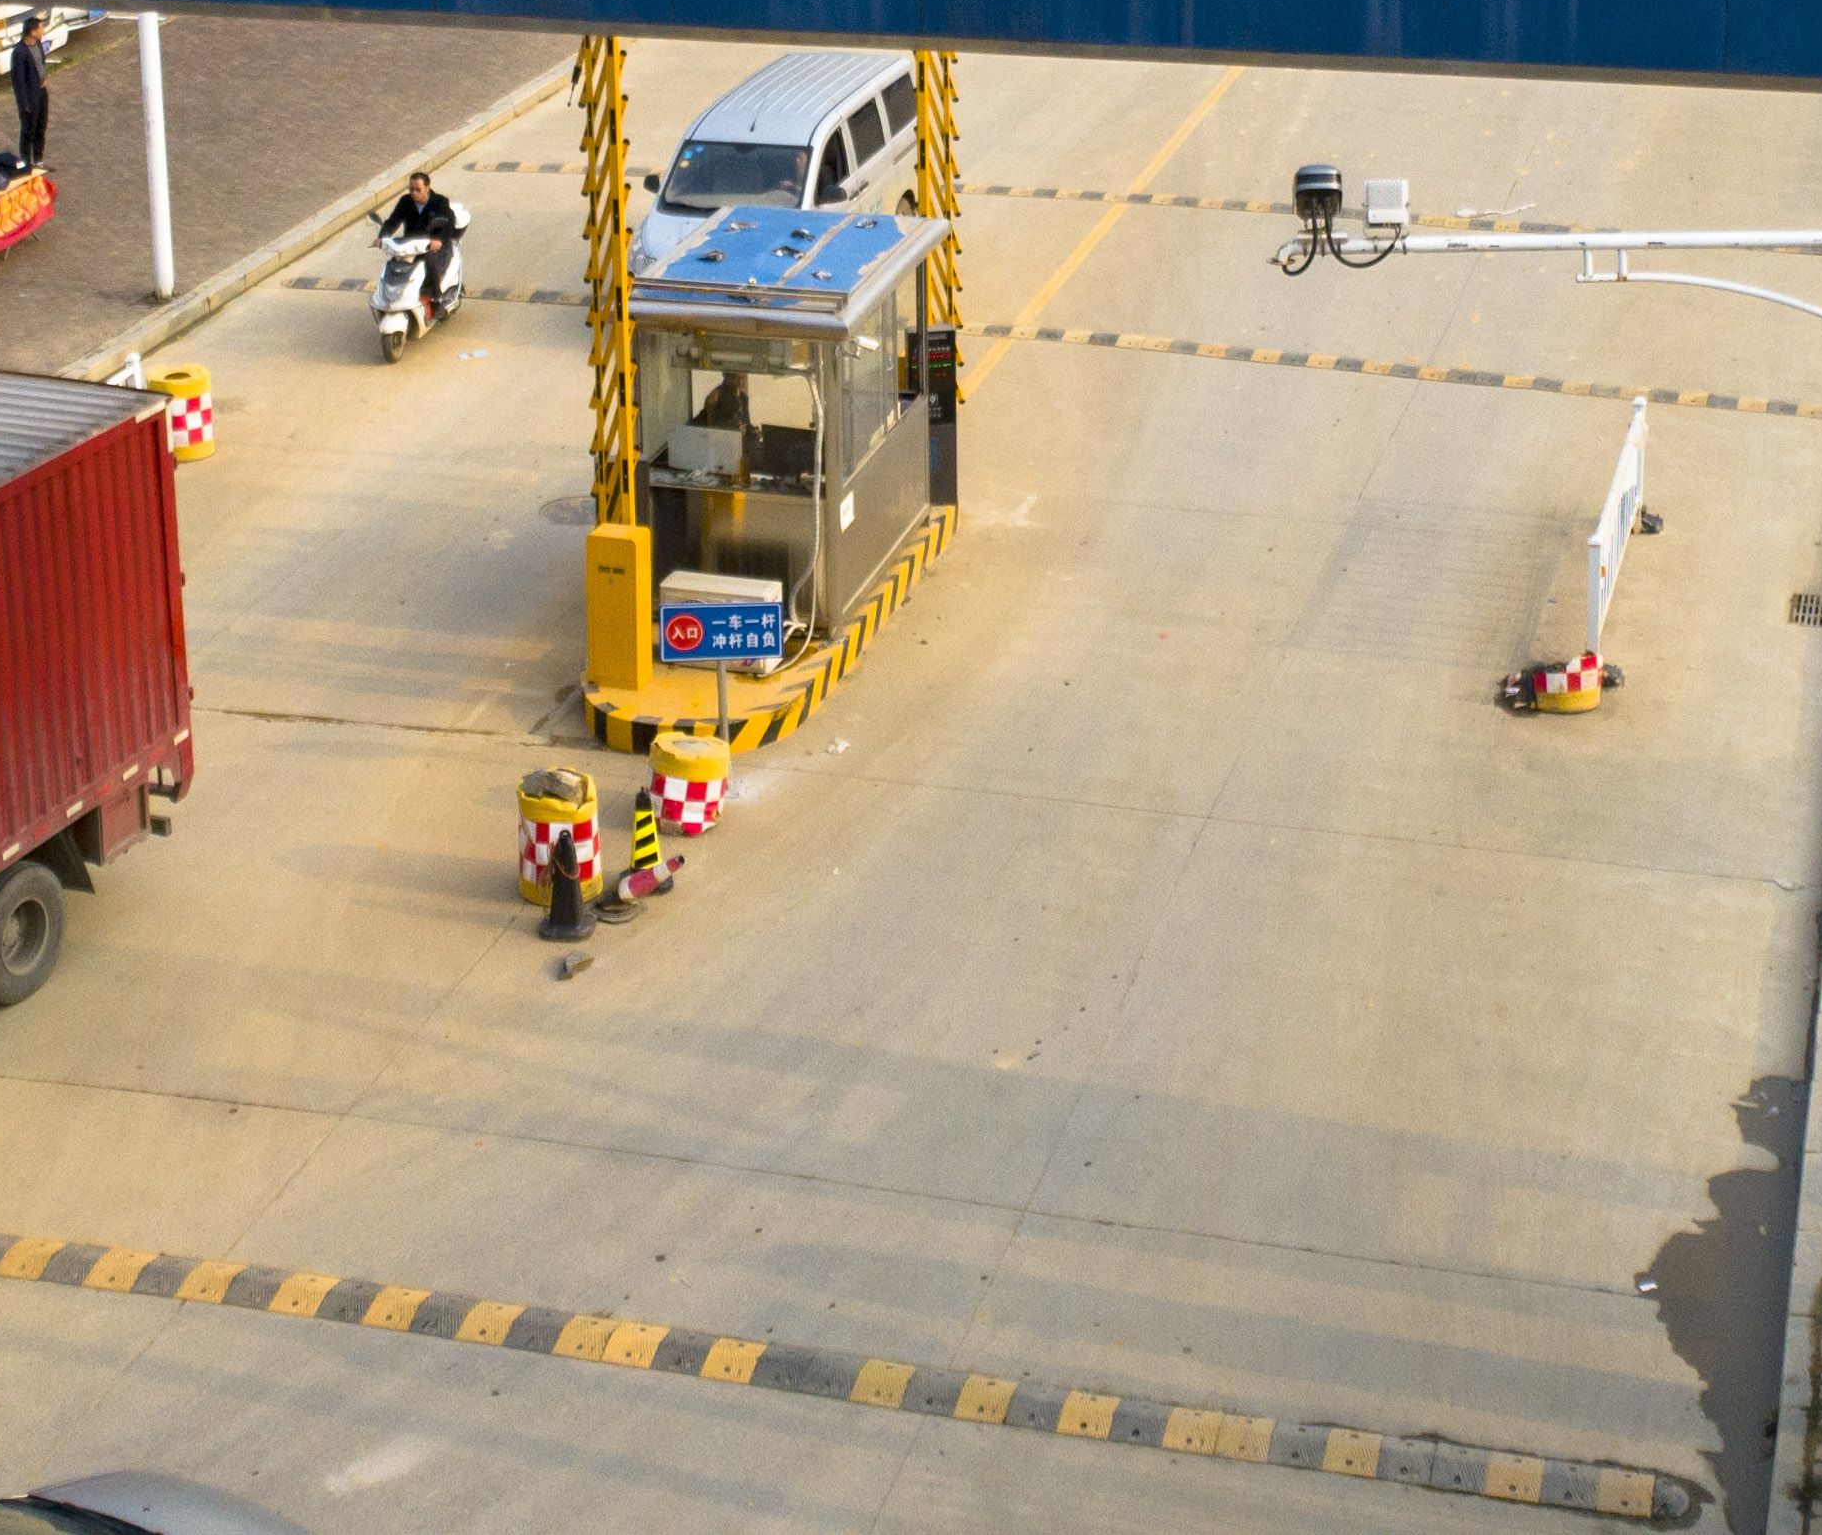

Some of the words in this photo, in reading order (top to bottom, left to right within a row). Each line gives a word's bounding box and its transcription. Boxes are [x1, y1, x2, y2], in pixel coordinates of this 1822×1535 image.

[712, 614, 776, 630] 一车一杆
[672, 627, 698, 640] 入口
[712, 632, 776, 649] 冲杆自负
